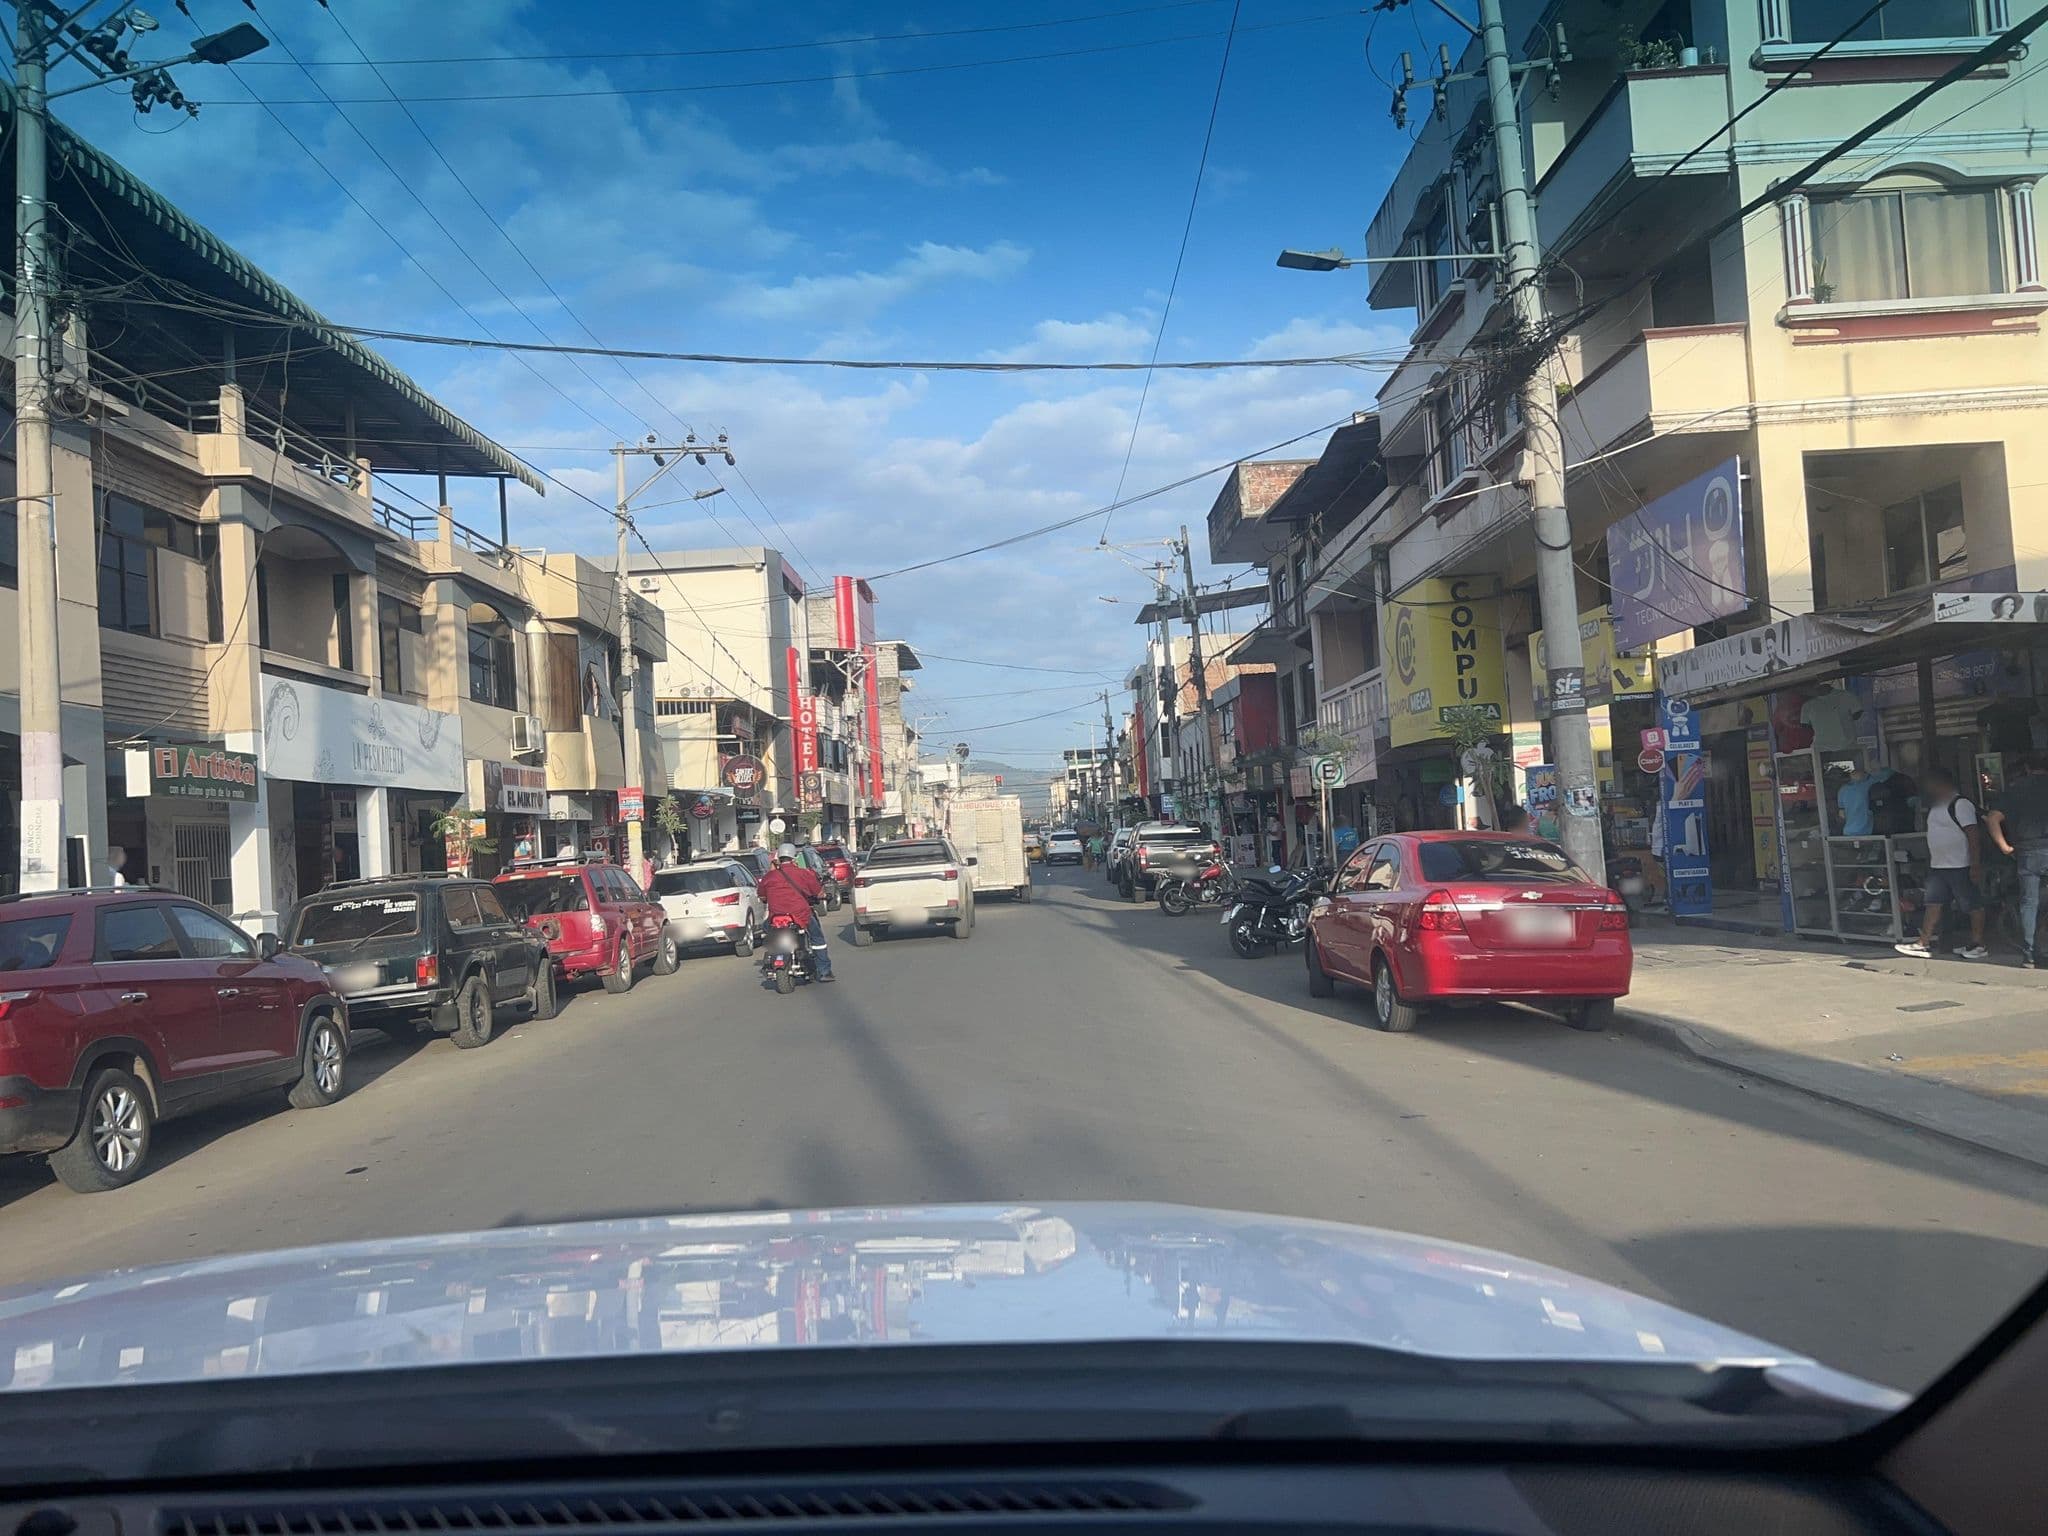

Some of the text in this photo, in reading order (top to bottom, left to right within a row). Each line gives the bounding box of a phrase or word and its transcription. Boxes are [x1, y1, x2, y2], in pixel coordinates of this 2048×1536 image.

[1451, 581, 1478, 700] COMPU
[1410, 688, 1431, 713] MEGA
[800, 697, 814, 772] HOTEL
[154, 747, 255, 787] El Artista
[1322, 763, 1336, 780] E
[1640, 756, 1657, 765] Claro
[507, 791, 516, 807] EL
